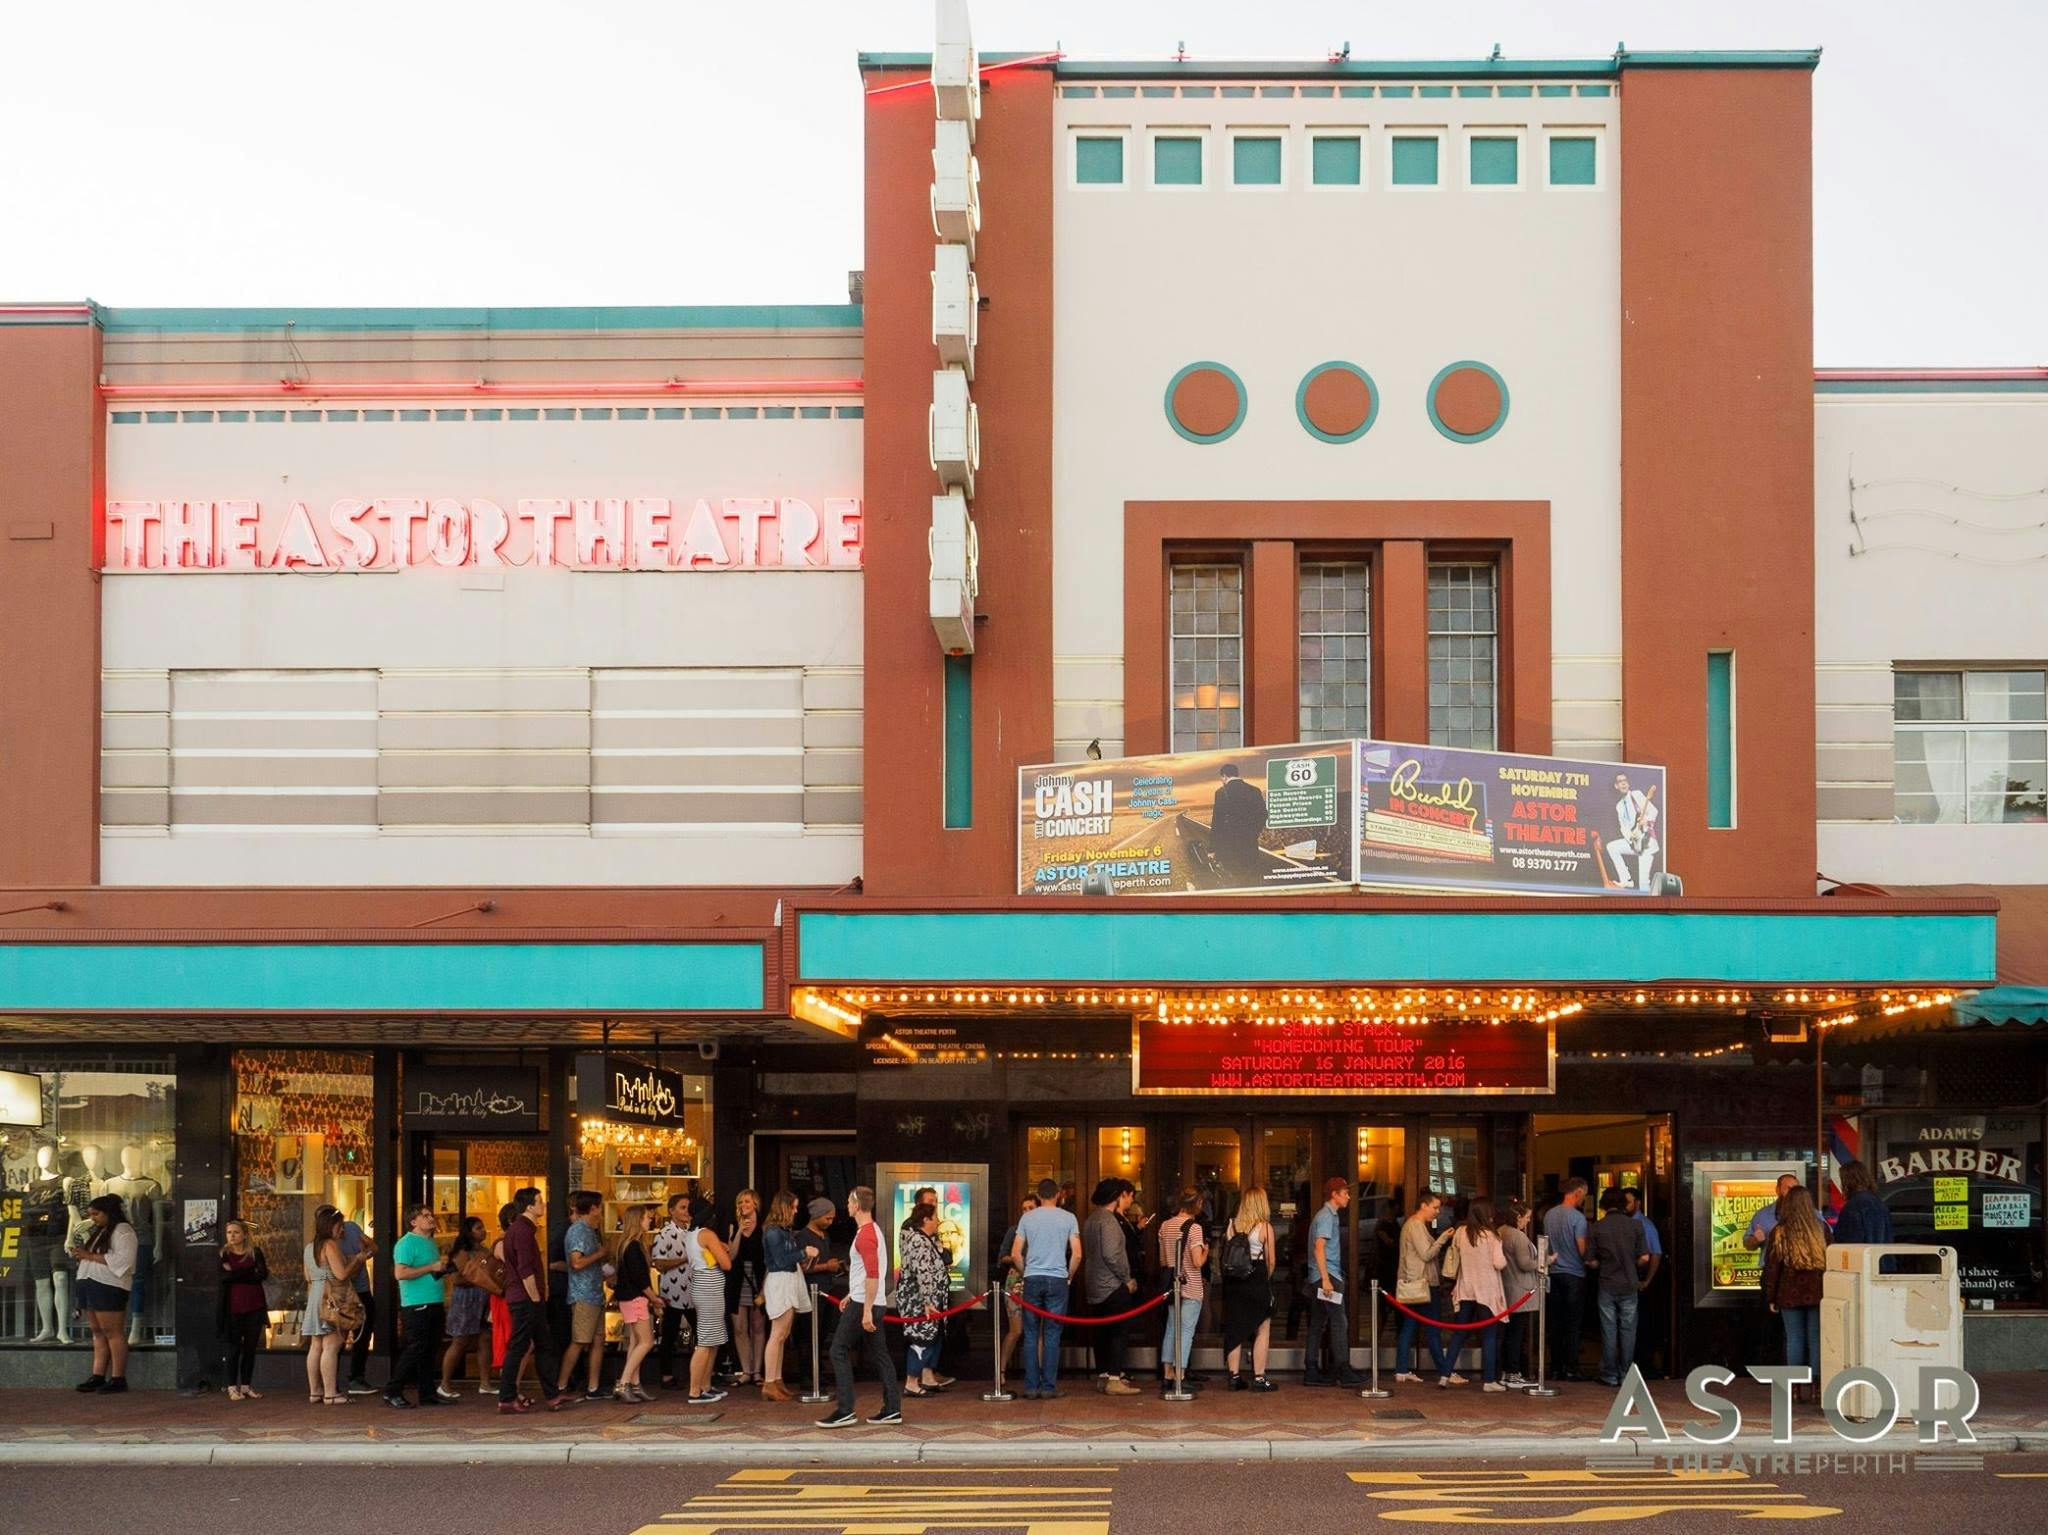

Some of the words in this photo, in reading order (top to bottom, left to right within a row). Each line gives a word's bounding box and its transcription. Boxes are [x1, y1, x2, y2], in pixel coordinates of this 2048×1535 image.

[107, 499, 261, 568] THE
[273, 498, 510, 569] ASTOR
[518, 497, 863, 568] THEATRE
[1034, 774, 1073, 788] Johnny
[1291, 769, 1311, 781] 60
[1499, 767, 1563, 785] SATURDAY
[1565, 772, 1589, 786] 7TH
[1035, 780, 1112, 818] CASH
[1390, 759, 1478, 836] Buddy
[1511, 784, 1578, 800] NOVEMBER
[1128, 799, 1156, 808] Johnny
[1157, 798, 1177, 806] Cash
[1512, 800, 1577, 822] ASTOR
[1407, 802, 1474, 827] CONCERT
[1046, 816, 1112, 838] CONCERT
[1504, 822, 1587, 845] THEATRE
[1043, 852, 1082, 863] Friday
[1085, 848, 1149, 862] November
[1152, 846, 1162, 856] 6
[1499, 847, 1591, 859] www.astortheatreperth.com
[1035, 865, 1089, 882] ASTOR
[1094, 860, 1171, 878] THEATRE
[1512, 857, 1525, 868] 08
[1527, 858, 1551, 870] 9370
[1554, 859, 1578, 871] 1777
[1282, 1023, 1332, 1036] SHORT
[1253, 1040, 1364, 1053] "HOMECOMING
[1374, 1040, 1423, 1053] TOUR"
[1221, 1056, 1303, 1070] SATURDAY
[1316, 1056, 1334, 1070] 16
[1343, 1056, 1415, 1070] JANUARY
[1424, 1056, 1465, 1070] 2016
[1211, 1073, 1465, 1087] WWW.ASTORTHEATREPERTH.COM
[1918, 1128, 1984, 1141] ADAM'S
[1880, 1147, 2023, 1184] BARBER
[0, 1198, 22, 1220] SE
[1968, 1267, 1999, 1276] shave
[1998, 1279, 2015, 1288] etc
